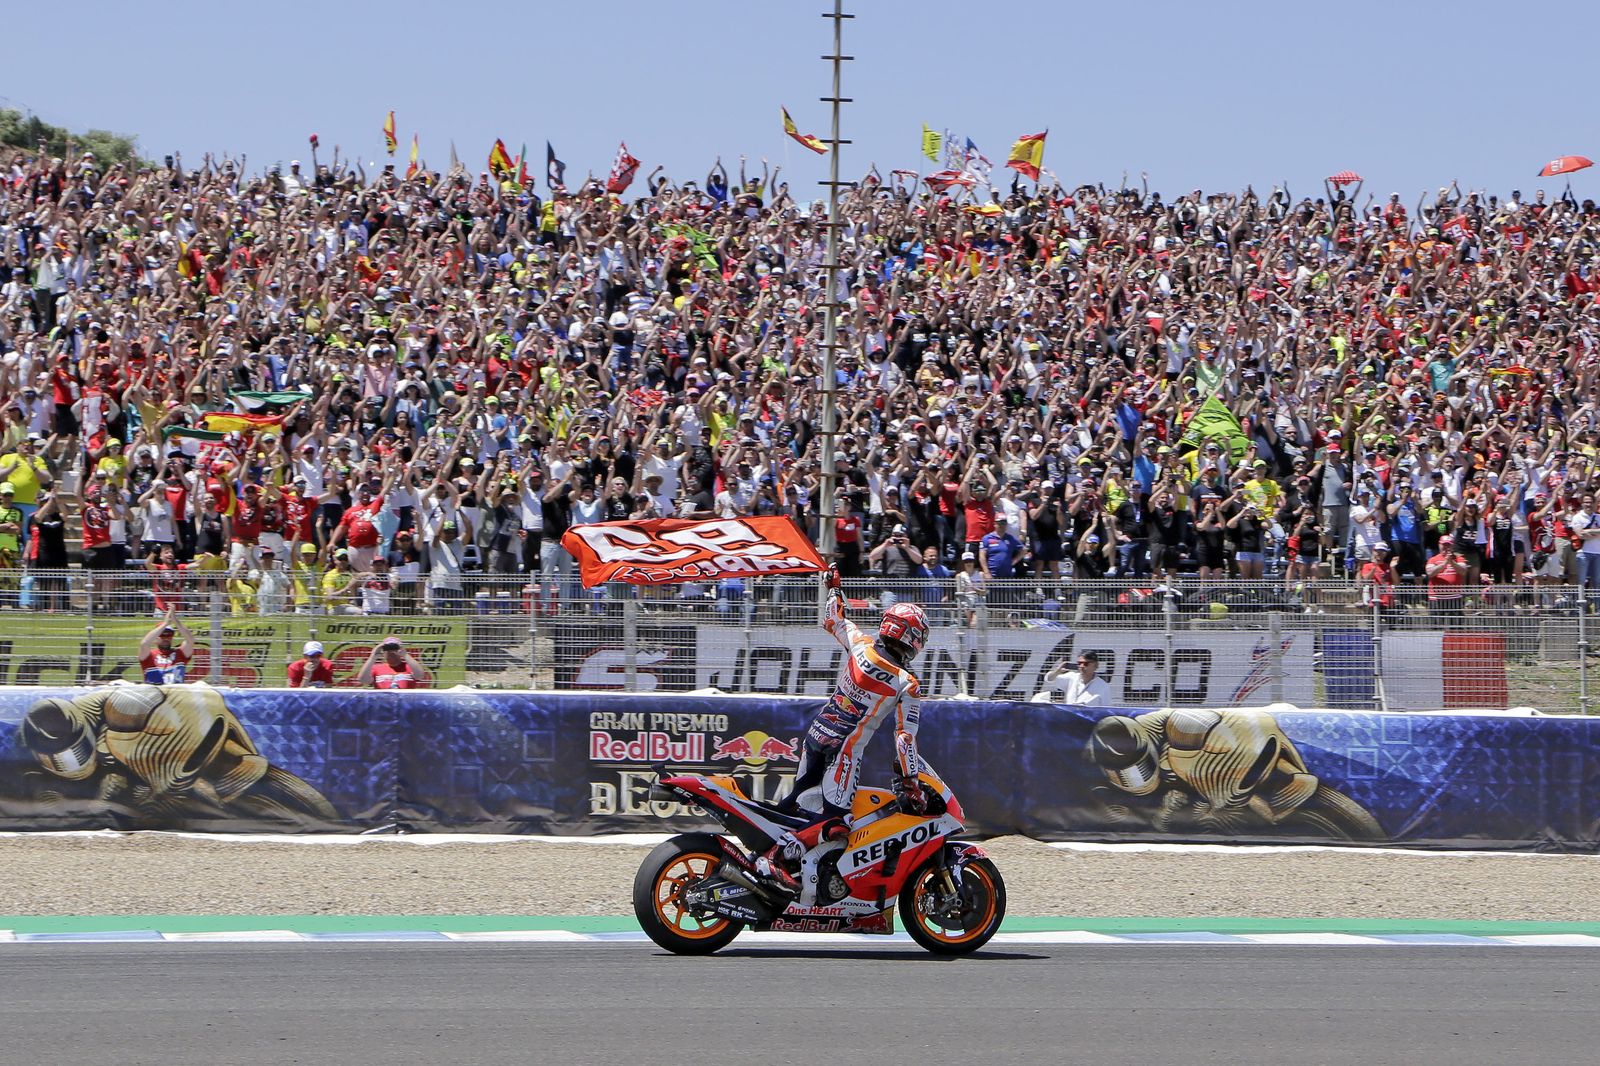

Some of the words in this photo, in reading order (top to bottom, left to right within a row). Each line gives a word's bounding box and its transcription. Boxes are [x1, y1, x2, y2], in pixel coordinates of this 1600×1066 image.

[326, 623, 384, 635] official
[388, 624, 414, 635] fan
[419, 623, 452, 635] club
[708, 645, 980, 695] JOHN
[843, 674, 872, 701] HONDA
[589, 711, 645, 731] GRAN
[650, 713, 729, 735] PREMIO
[589, 731, 648, 760] Red
[649, 731, 705, 762] Bull
[852, 821, 941, 868] REPSOL
[787, 906, 807, 915] One
[840, 901, 872, 913] HONDA
